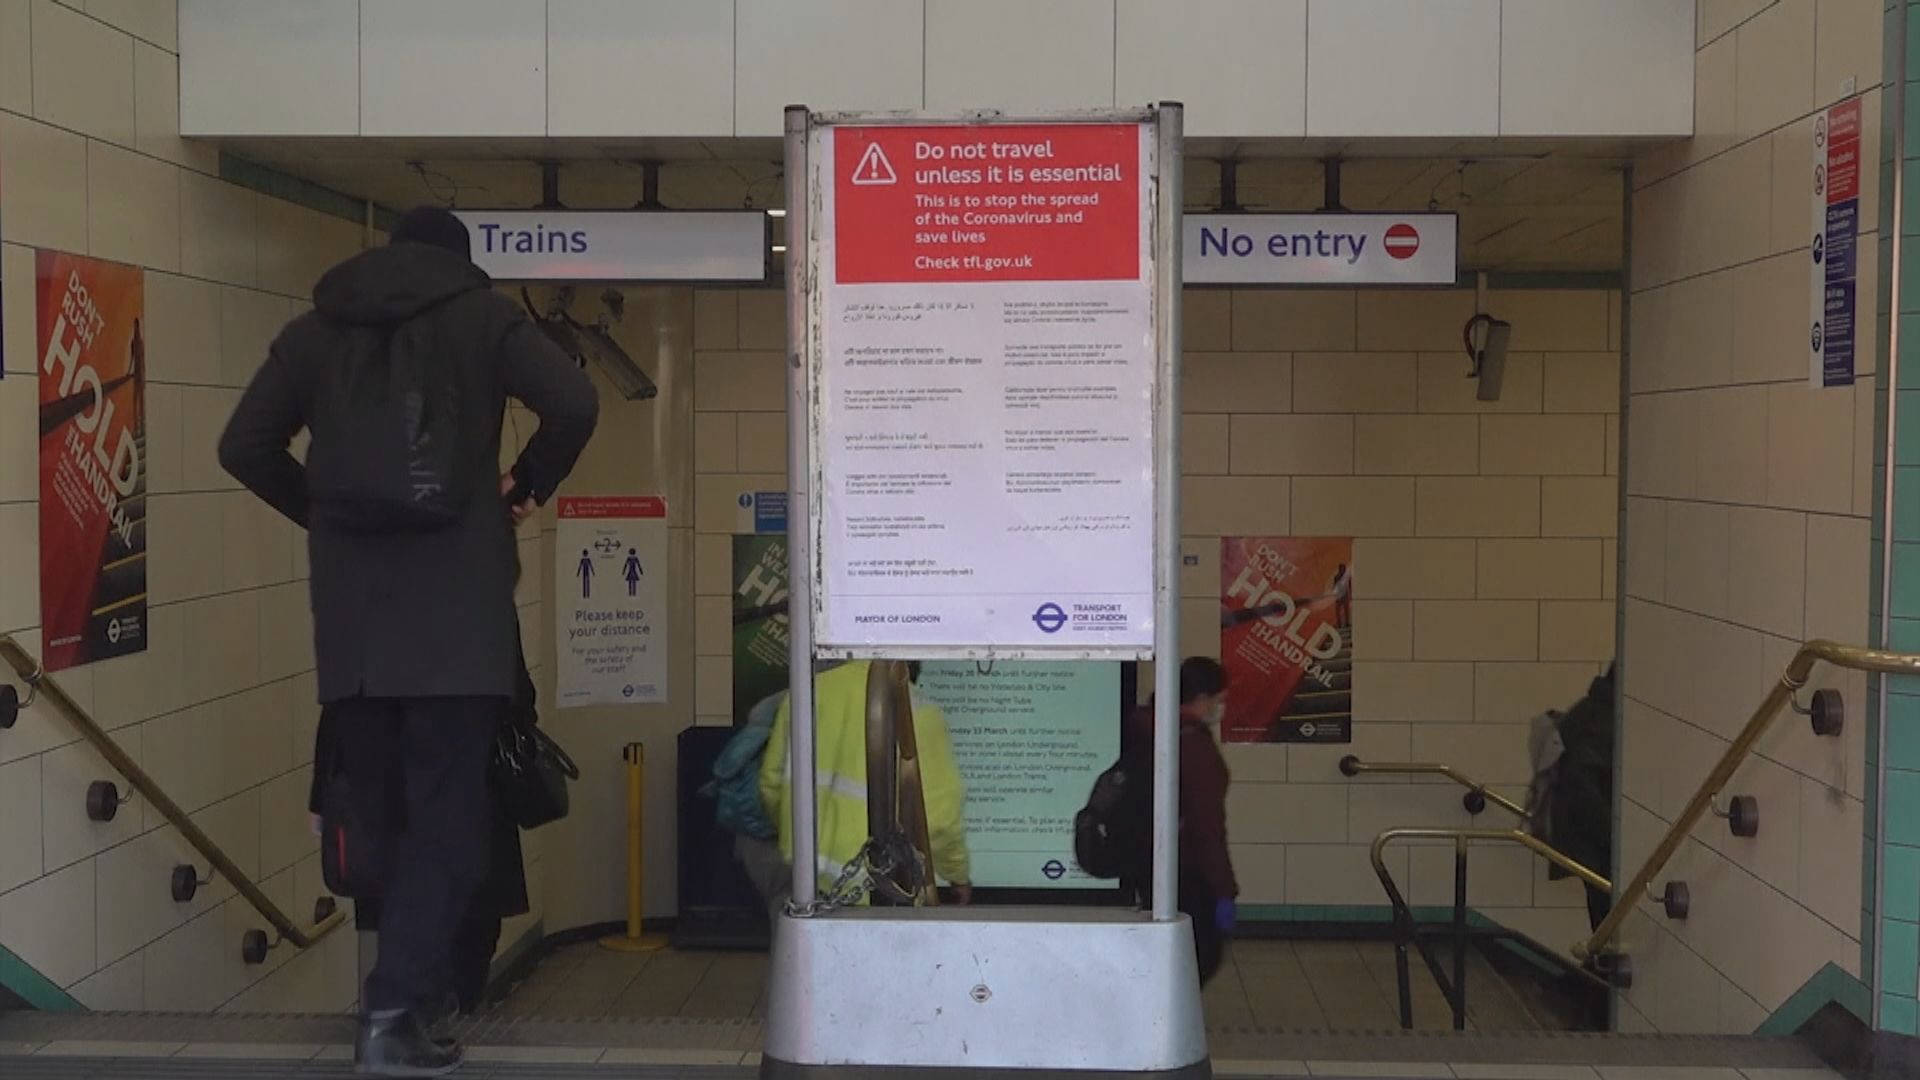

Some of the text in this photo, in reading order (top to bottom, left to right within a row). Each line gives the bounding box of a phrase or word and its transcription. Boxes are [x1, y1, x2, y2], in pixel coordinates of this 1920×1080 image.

[915, 140, 1053, 160] Do not travel
[915, 164, 1122, 184] unless it is essential
[915, 193, 1099, 210] This is to stop the spread
[915, 210, 1084, 225] of the Coronavirus and
[478, 223, 589, 254] Trains
[915, 230, 987, 244] save lives
[1199, 227, 1368, 265] No entry
[915, 255, 1033, 272] Check tfl.gov.uk
[62, 290, 94, 350] RUSH
[43, 312, 139, 496] HOLD
[70, 431, 134, 549] HANDRAIL
[1248, 554, 1286, 584] RUSH
[575, 608, 644, 622] Please keep
[1073, 604, 1122, 612] TRANSPORT
[1226, 566, 1342, 660] HOLD
[855, 615, 941, 624] MAYOR OF LONDON
[1073, 614, 1128, 622] FOR LONDON
[569, 624, 650, 641] your distance
[1256, 626, 1334, 688] HANDRAIL
[941, 669, 964, 679] Friday
[961, 705, 1006, 715] Overground
[984, 727, 1008, 736] March
